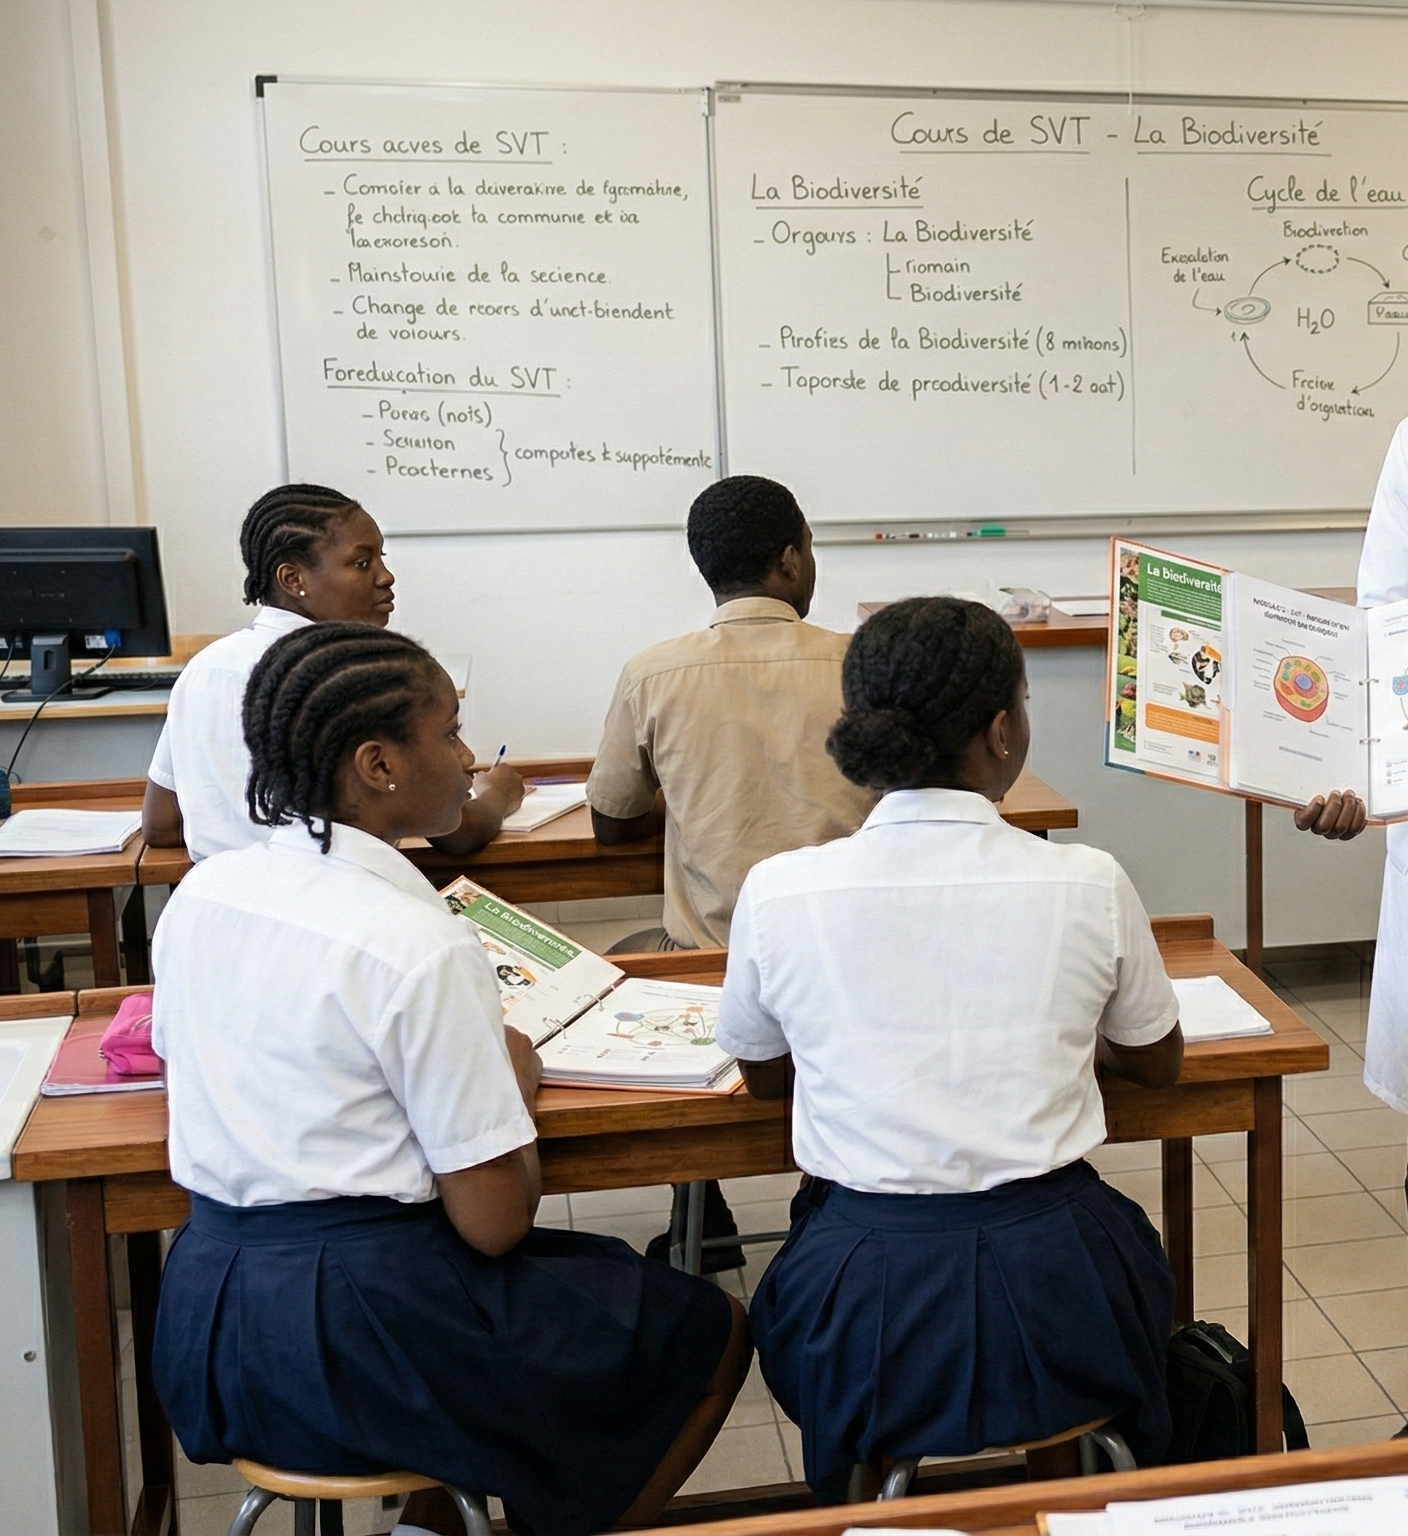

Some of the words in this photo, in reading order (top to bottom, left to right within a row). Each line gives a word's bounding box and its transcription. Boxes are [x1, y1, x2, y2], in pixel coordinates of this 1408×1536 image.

[299, 125, 371, 154] Cours
[454, 130, 482, 155] de
[496, 130, 549, 155] SVT
[891, 111, 969, 144] Cours
[982, 118, 1014, 144] de
[1030, 115, 1091, 145] SVT
[1133, 115, 1166, 144] La
[1182, 116, 1323, 146] Biodiversité
[447, 176, 465, 195] la
[576, 179, 595, 196] de
[751, 173, 781, 200] La
[791, 174, 923, 200] Biodiversité
[1247, 174, 1306, 213] Cycle
[1316, 179, 1340, 202] de
[1350, 175, 1406, 203] l'eau
[883, 220, 908, 243] La
[915, 219, 1034, 243] Biodiversité
[467, 263, 490, 283] de
[1173, 268, 1186, 283] de
[1192, 267, 1225, 282] l'eau
[910, 281, 1023, 303] Biodiversité
[352, 295, 426, 324] Change
[436, 297, 458, 316] de
[356, 322, 378, 340] de
[858, 328, 880, 350] de
[918, 326, 1030, 350] Biodiversité
[1036, 326, 1055, 357] (8
[469, 366, 498, 387] du
[510, 365, 557, 389] SVT
[878, 370, 901, 392] de
[1147, 563, 1160, 577] La
